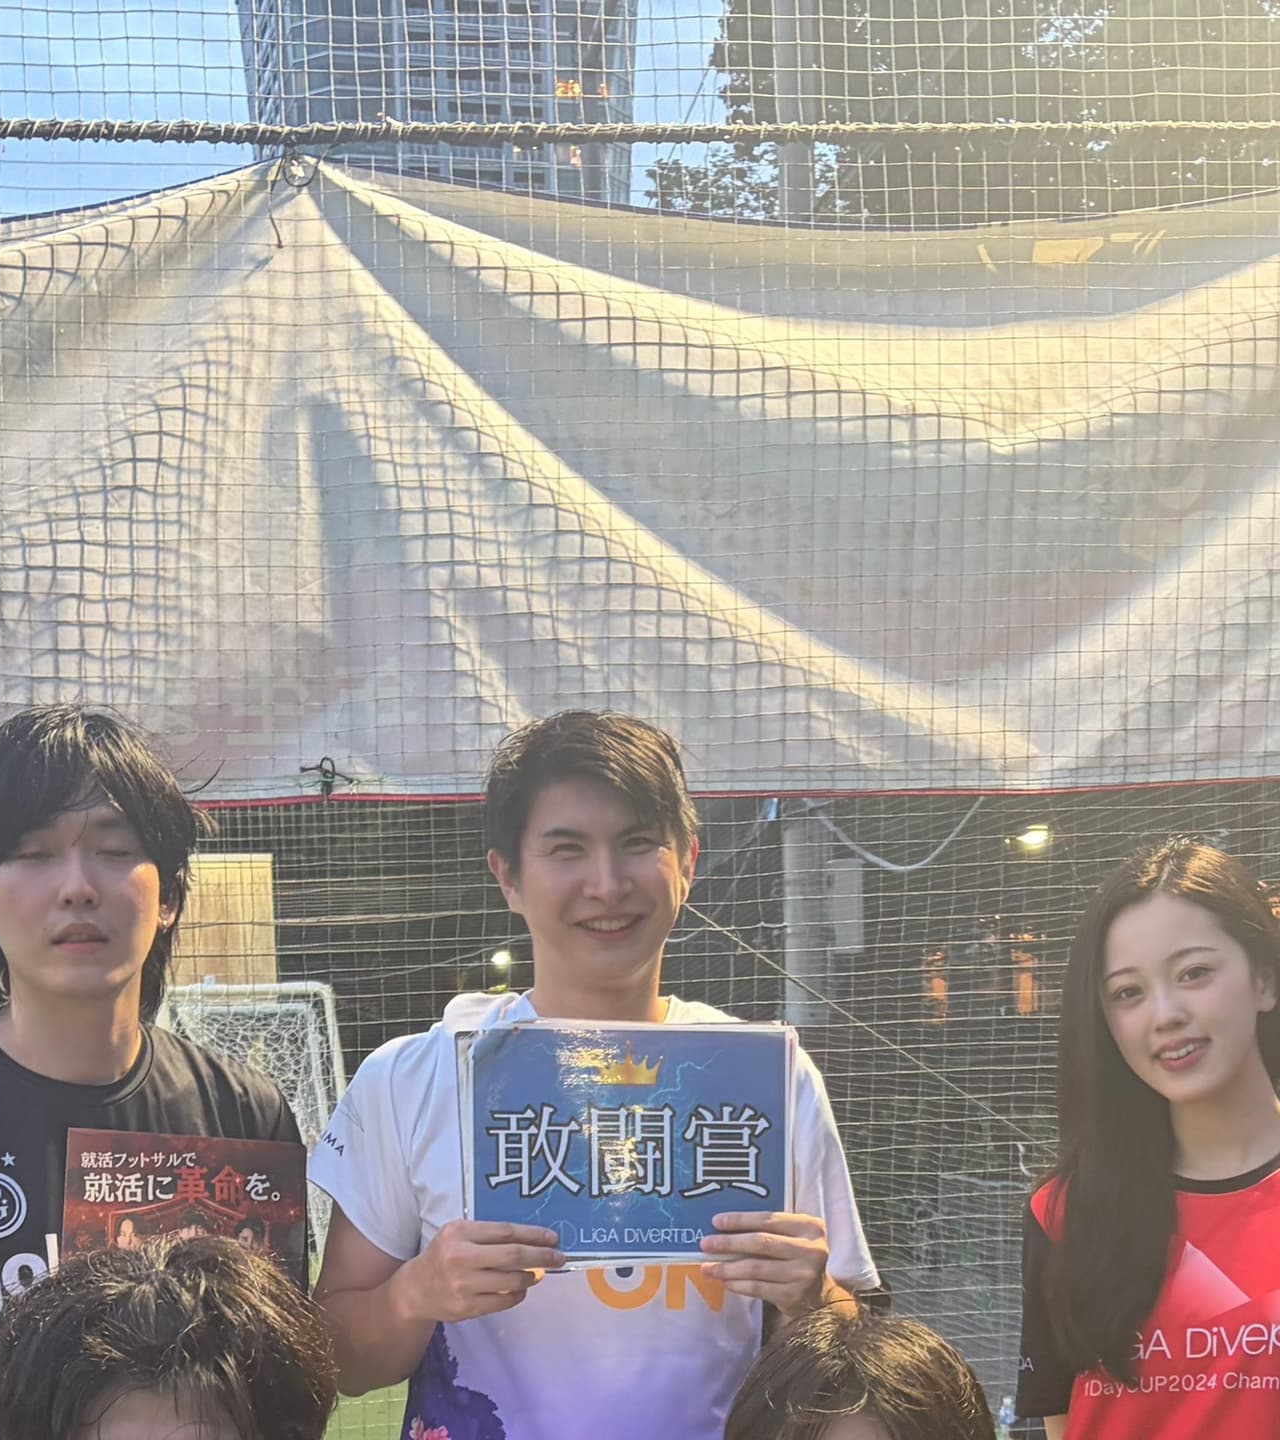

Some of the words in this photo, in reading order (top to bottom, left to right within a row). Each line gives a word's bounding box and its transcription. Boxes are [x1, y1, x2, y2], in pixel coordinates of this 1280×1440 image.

[81, 1151, 196, 1169] 就活フットサルで
[487, 1104, 771, 1198] 敢闘賞
[84, 1166, 281, 1203] 就活に革命を。
